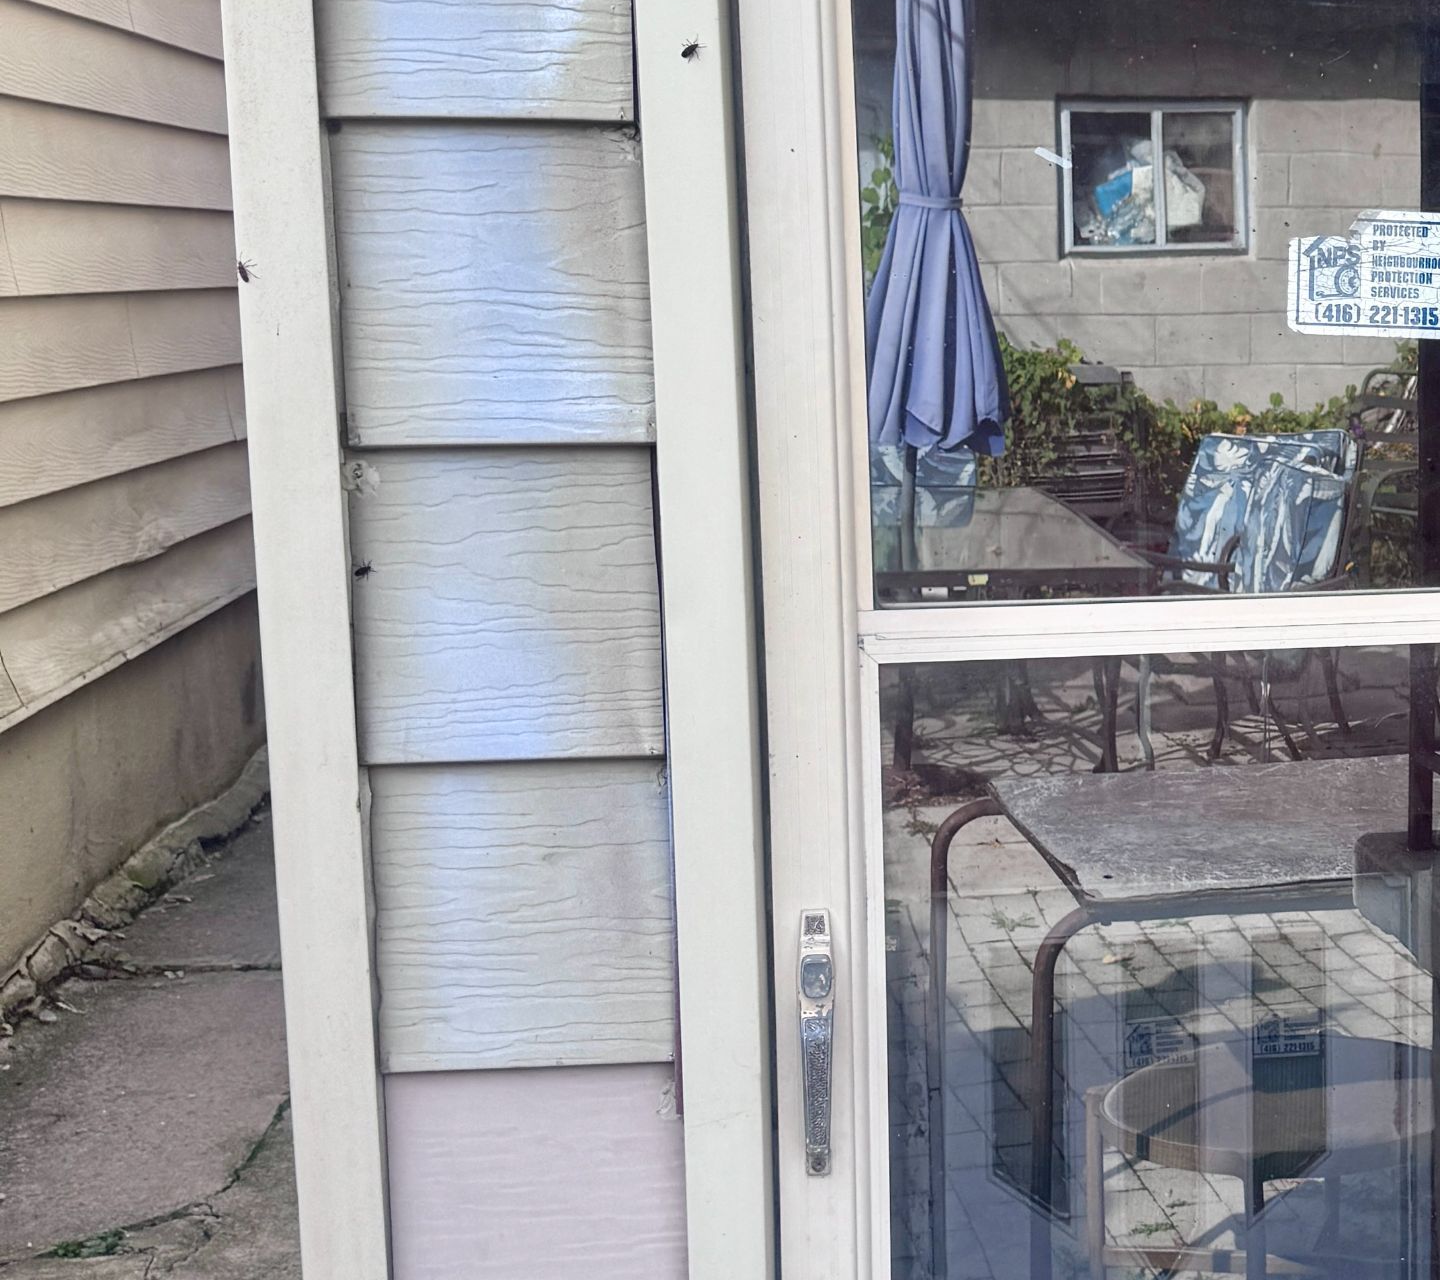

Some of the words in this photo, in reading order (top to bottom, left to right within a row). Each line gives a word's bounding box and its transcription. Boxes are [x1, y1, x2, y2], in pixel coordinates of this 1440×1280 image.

[1372, 223, 1429, 238] PROTECTED
[1372, 239, 1386, 251] BY
[1317, 245, 1361, 269] NPS
[1370, 270, 1433, 285] PROTECTION
[1370, 286, 1420, 299] SERVICES
[1314, 303, 1361, 323] (416)
[1369, 305, 1439, 326] 221-1315
